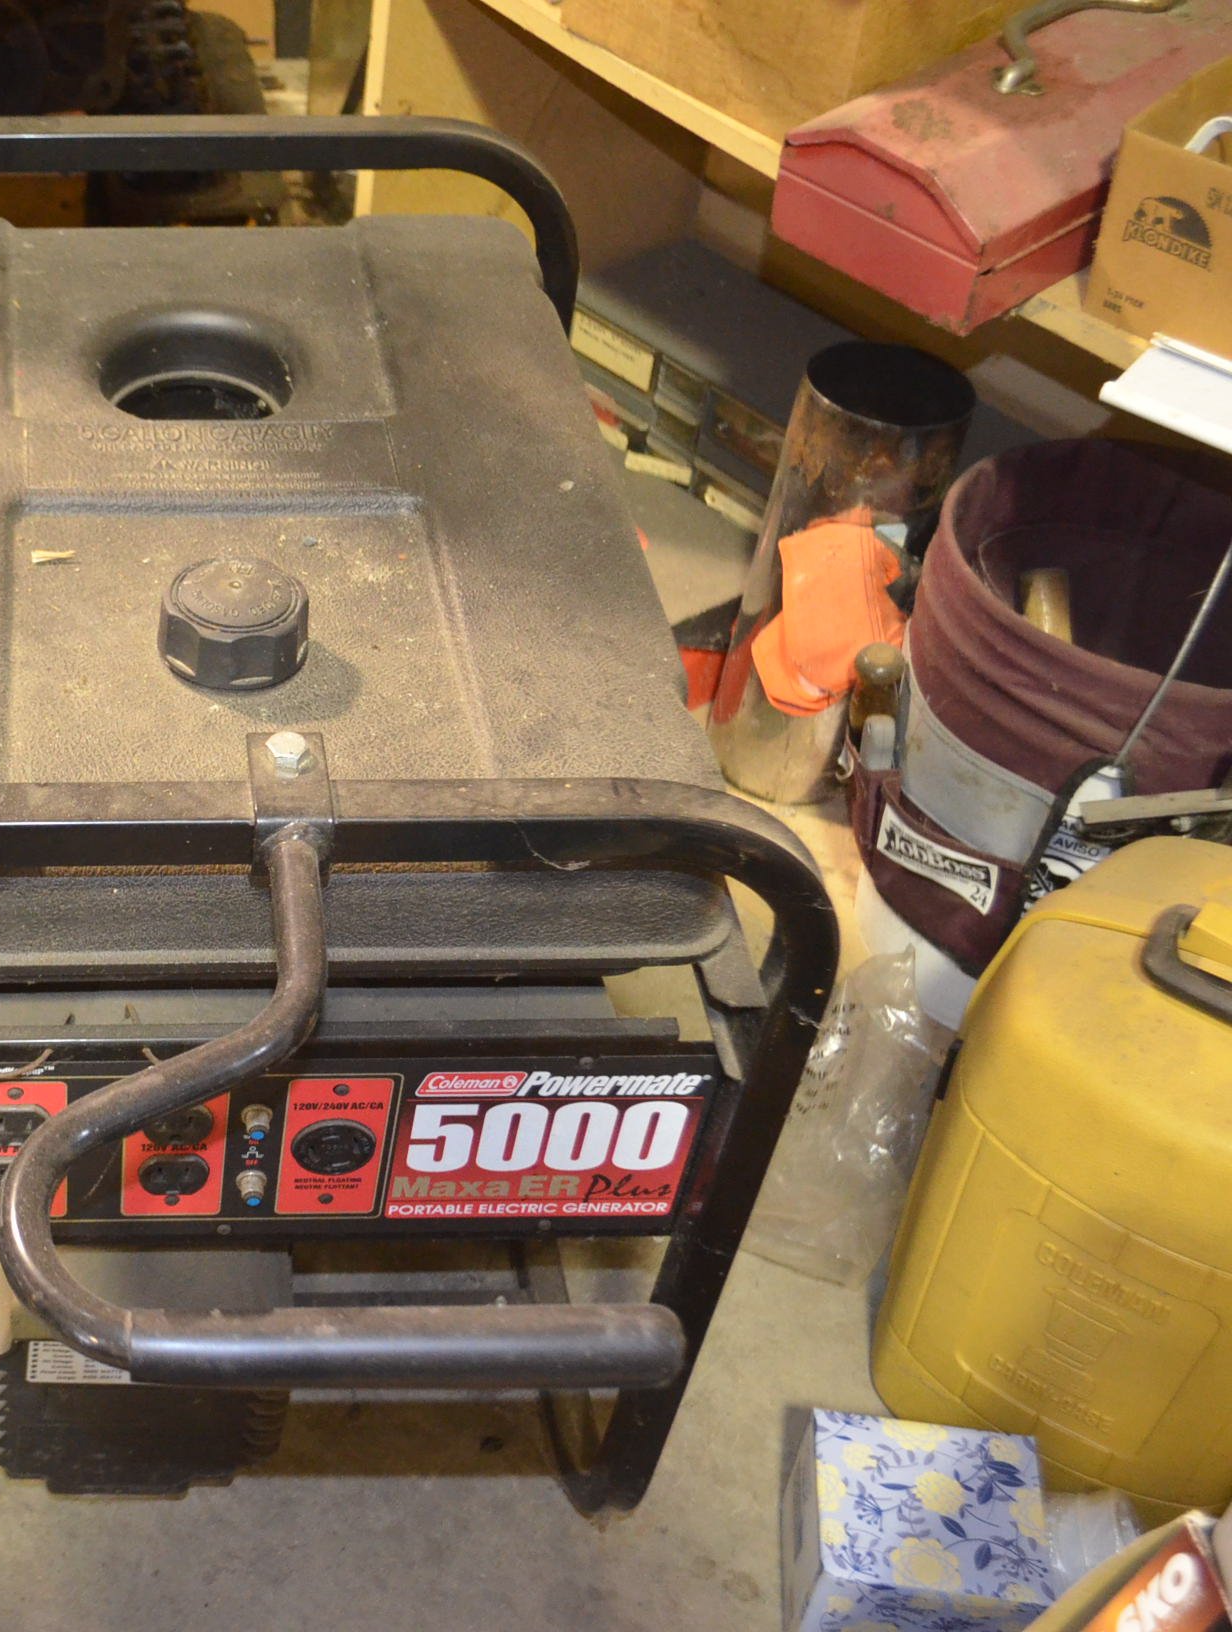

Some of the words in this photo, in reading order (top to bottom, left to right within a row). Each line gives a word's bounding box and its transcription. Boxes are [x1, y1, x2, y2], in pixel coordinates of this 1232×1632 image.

[1122, 219, 1212, 270] KLONDIKE
[99, 424, 206, 442] GALLON
[208, 423, 333, 442] CAPACITY
[1054, 837, 1100, 857] AVISO
[428, 1075, 501, 1090] Coleman
[515, 1071, 703, 1097] Powermate
[406, 1101, 689, 1172] 5000
[583, 1174, 672, 1203] Plus
[388, 1204, 474, 1216] PORTABLE
[478, 1203, 558, 1215] ELECTRIC
[562, 1201, 668, 1214] GENERATOR
[1036, 1240, 1171, 1327] COLEMAN
